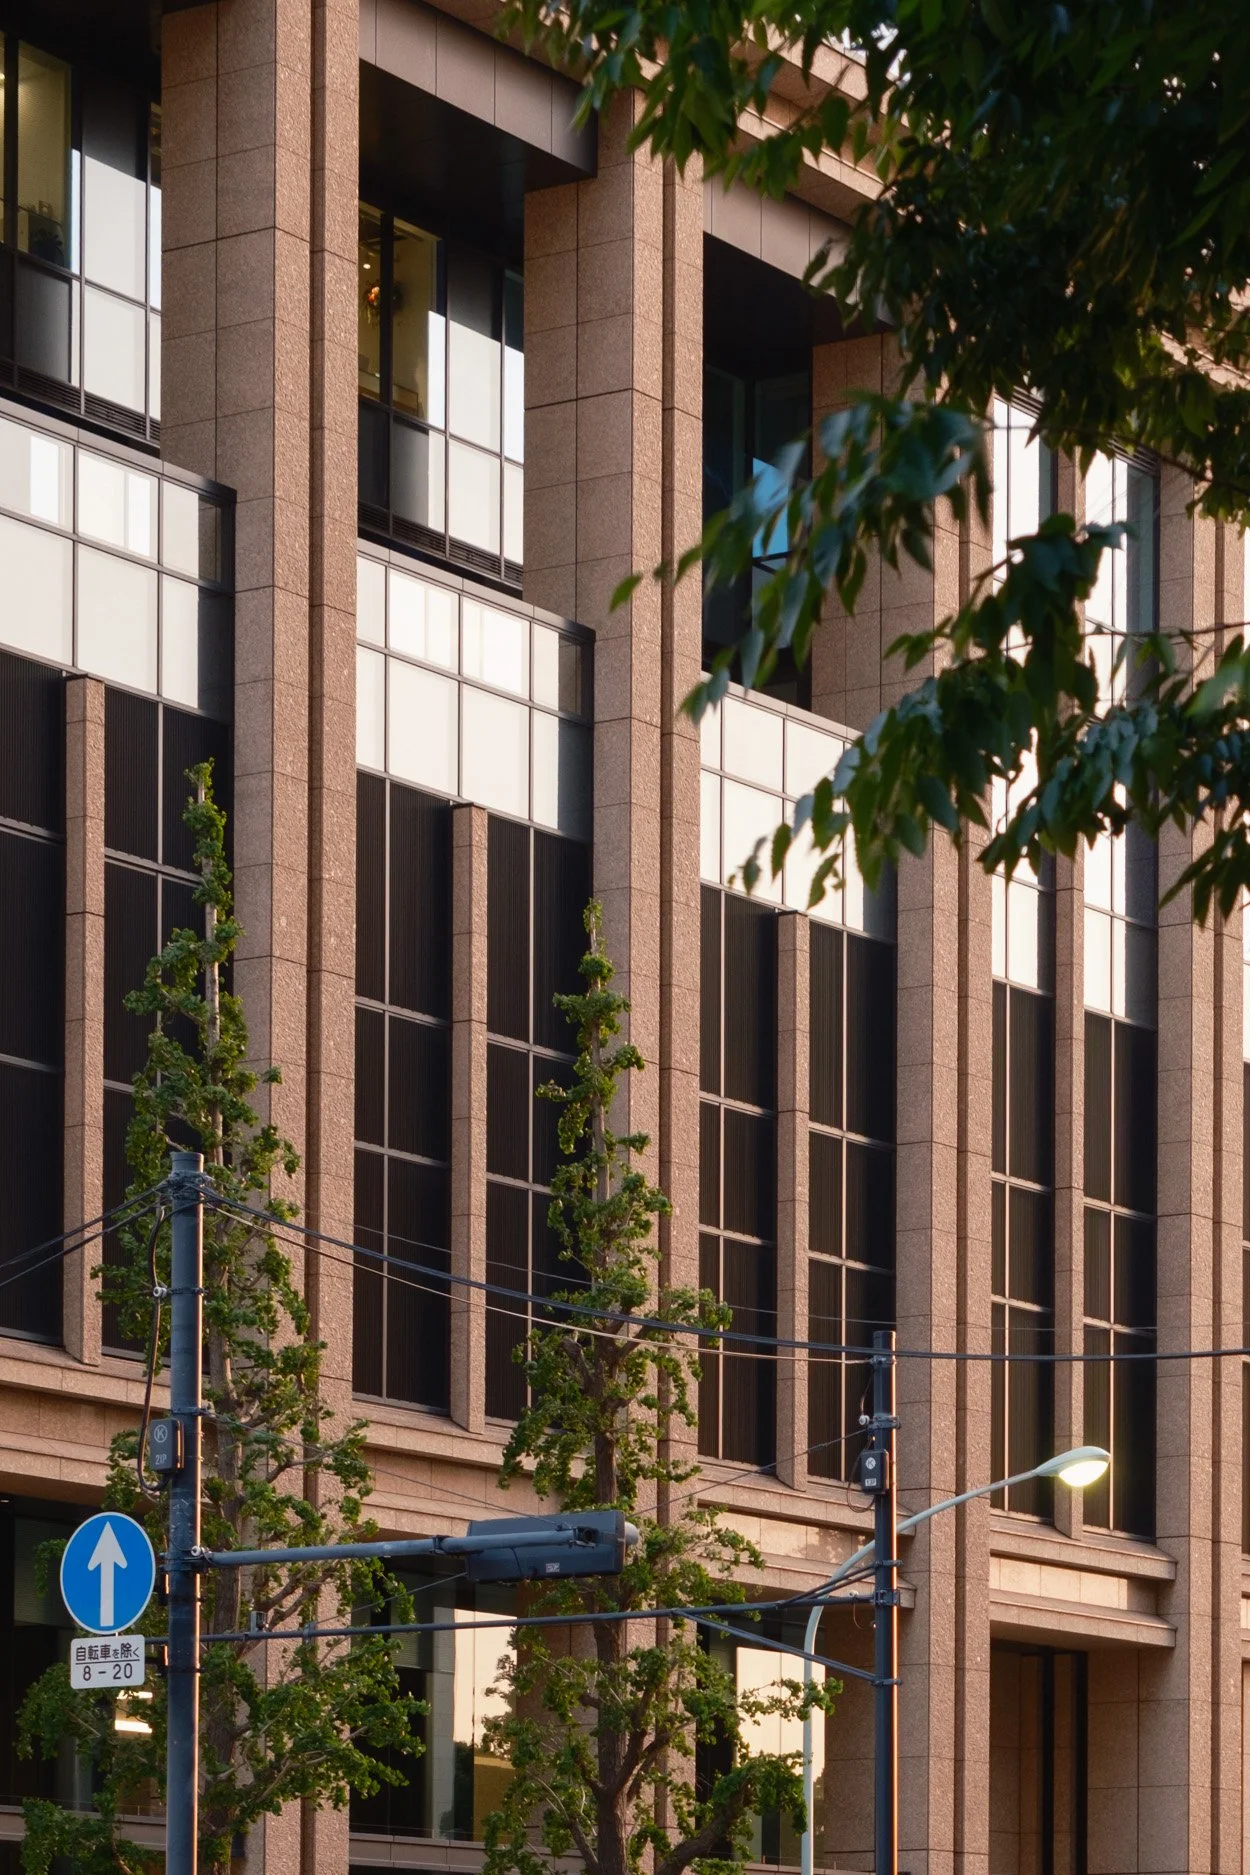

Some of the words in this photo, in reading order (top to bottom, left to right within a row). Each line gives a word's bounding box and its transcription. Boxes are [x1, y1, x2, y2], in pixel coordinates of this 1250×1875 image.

[76, 1642, 140, 1661] 自転車を除く
